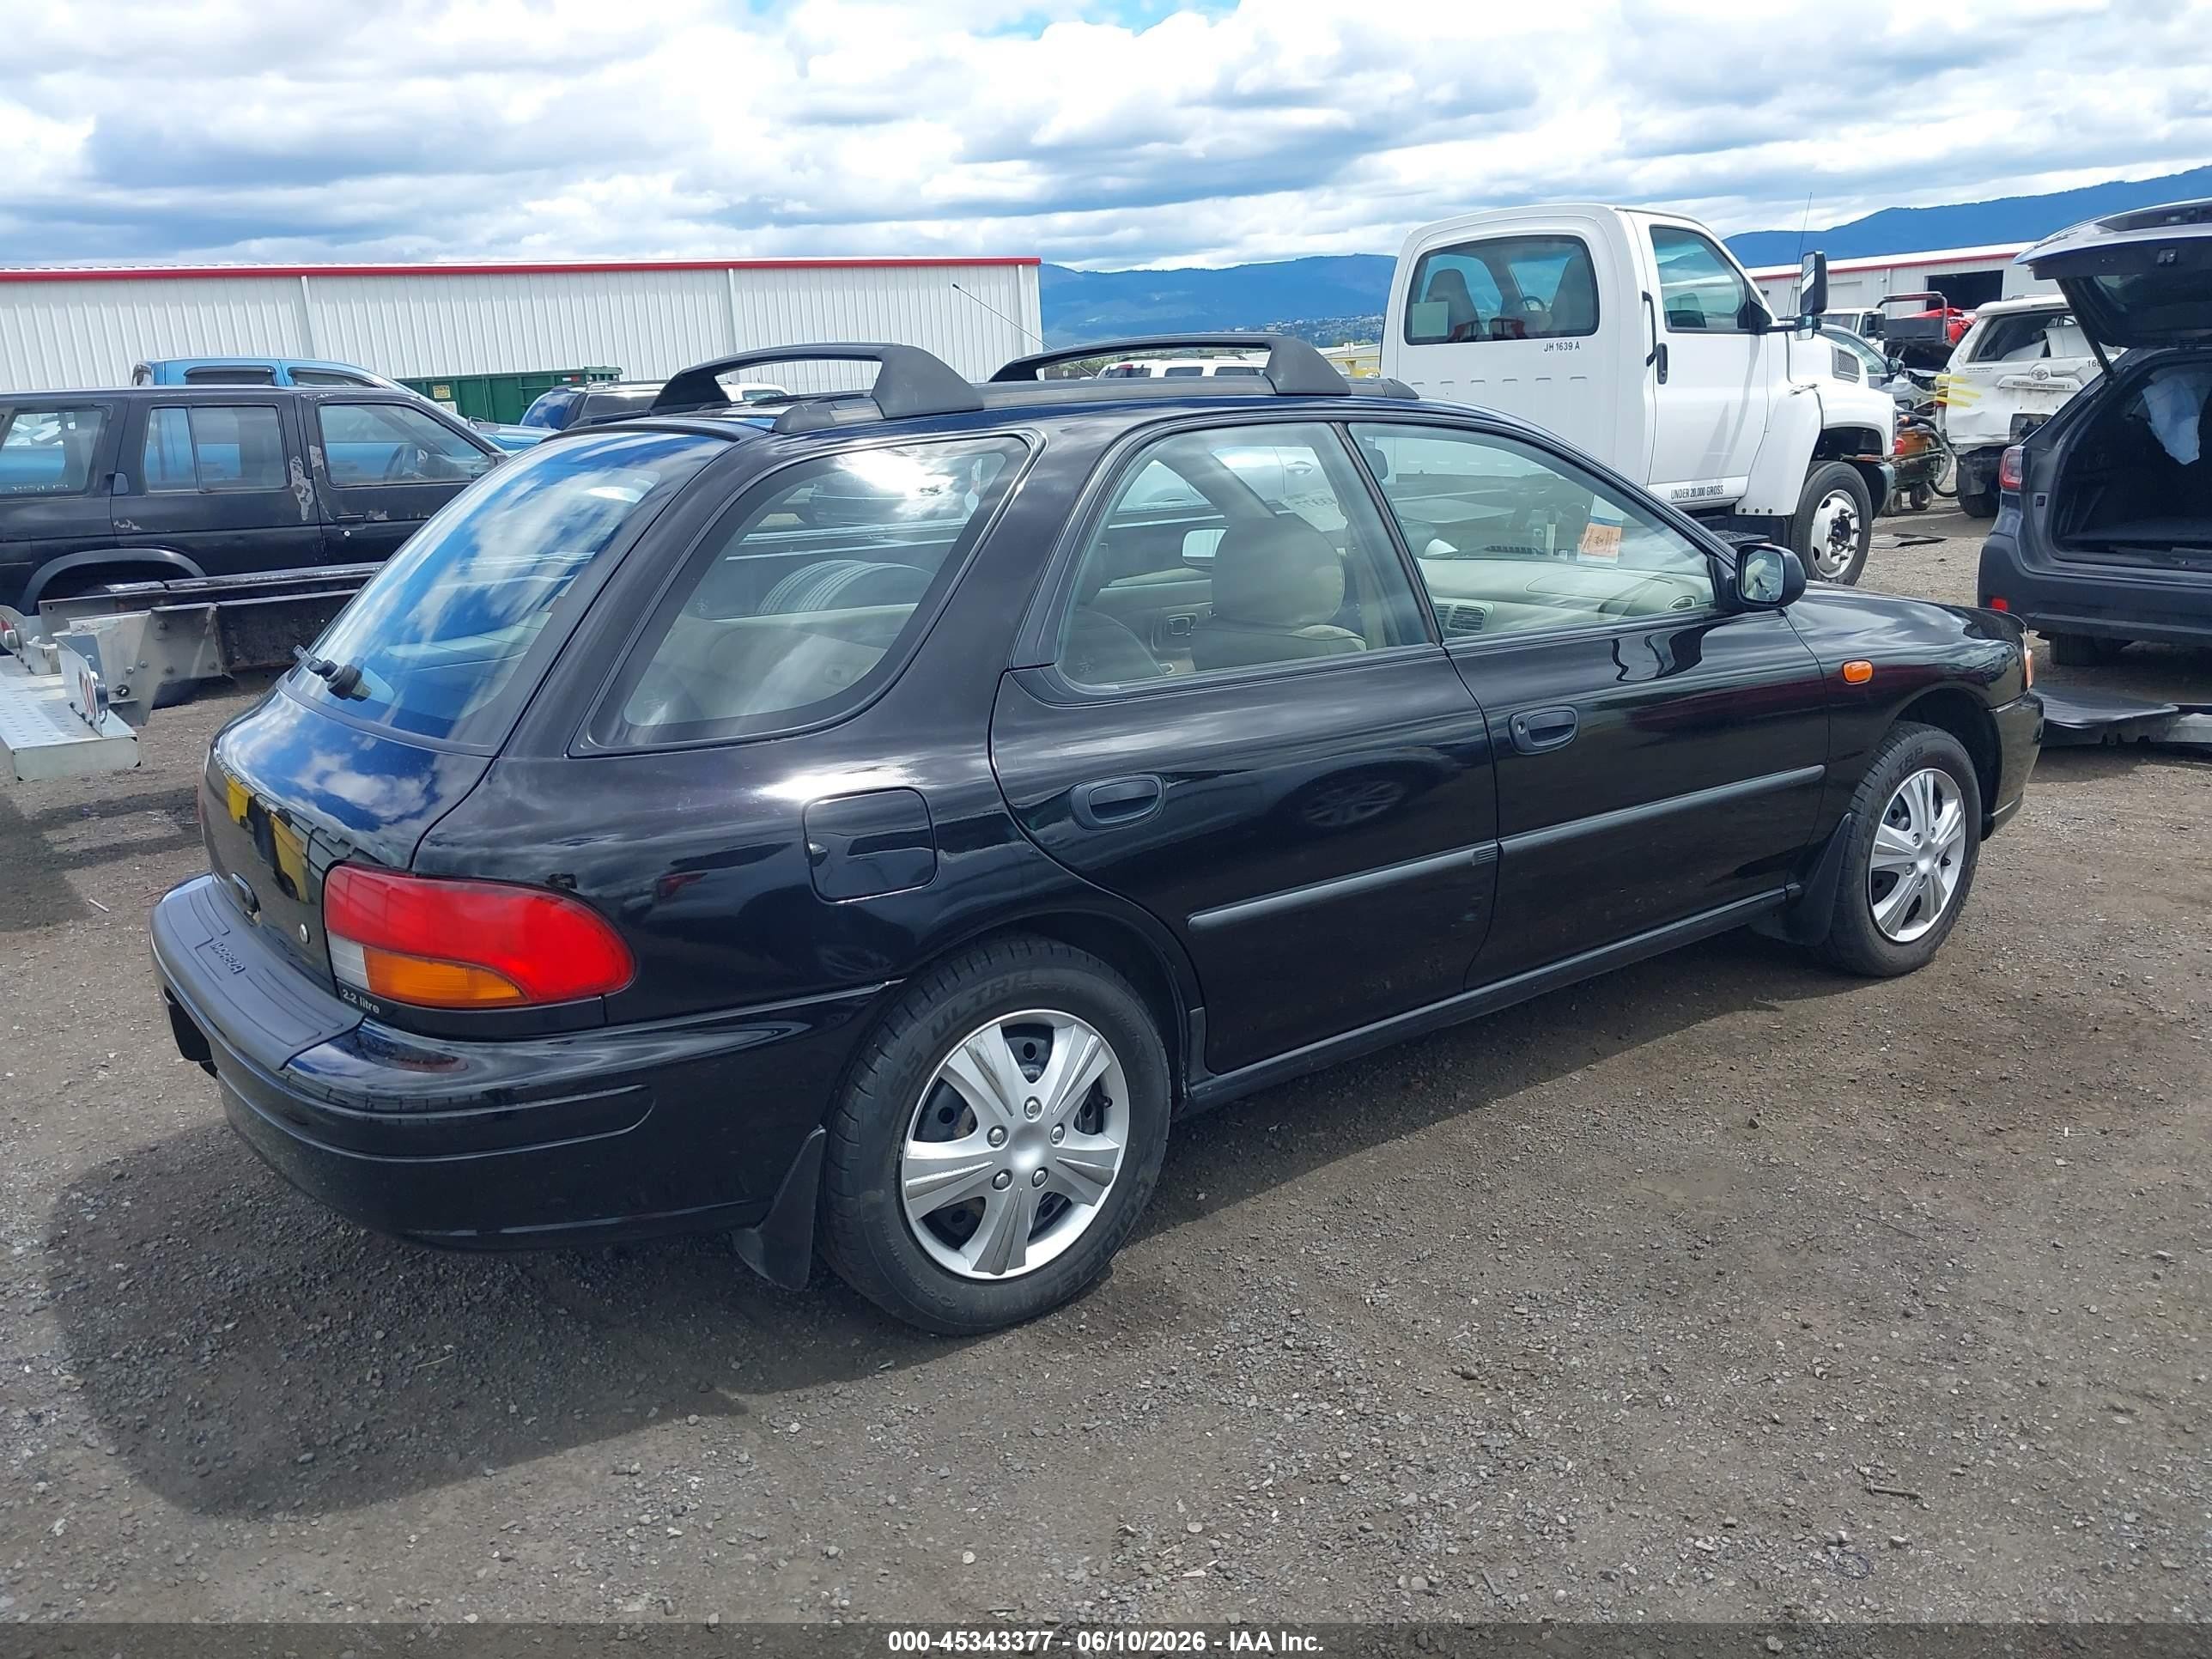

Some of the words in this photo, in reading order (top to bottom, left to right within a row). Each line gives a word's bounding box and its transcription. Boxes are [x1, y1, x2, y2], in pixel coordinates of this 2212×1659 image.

[1543, 342, 1554, 352] JH
[1555, 342, 1573, 351] 1639
[1574, 340, 1581, 350] A
[1670, 488, 1690, 500] UNDER
[1690, 486, 1706, 498] 20,000
[1706, 484, 1724, 495] GROSS
[343, 988, 357, 1004] 2.2
[359, 995, 380, 1014] litre
